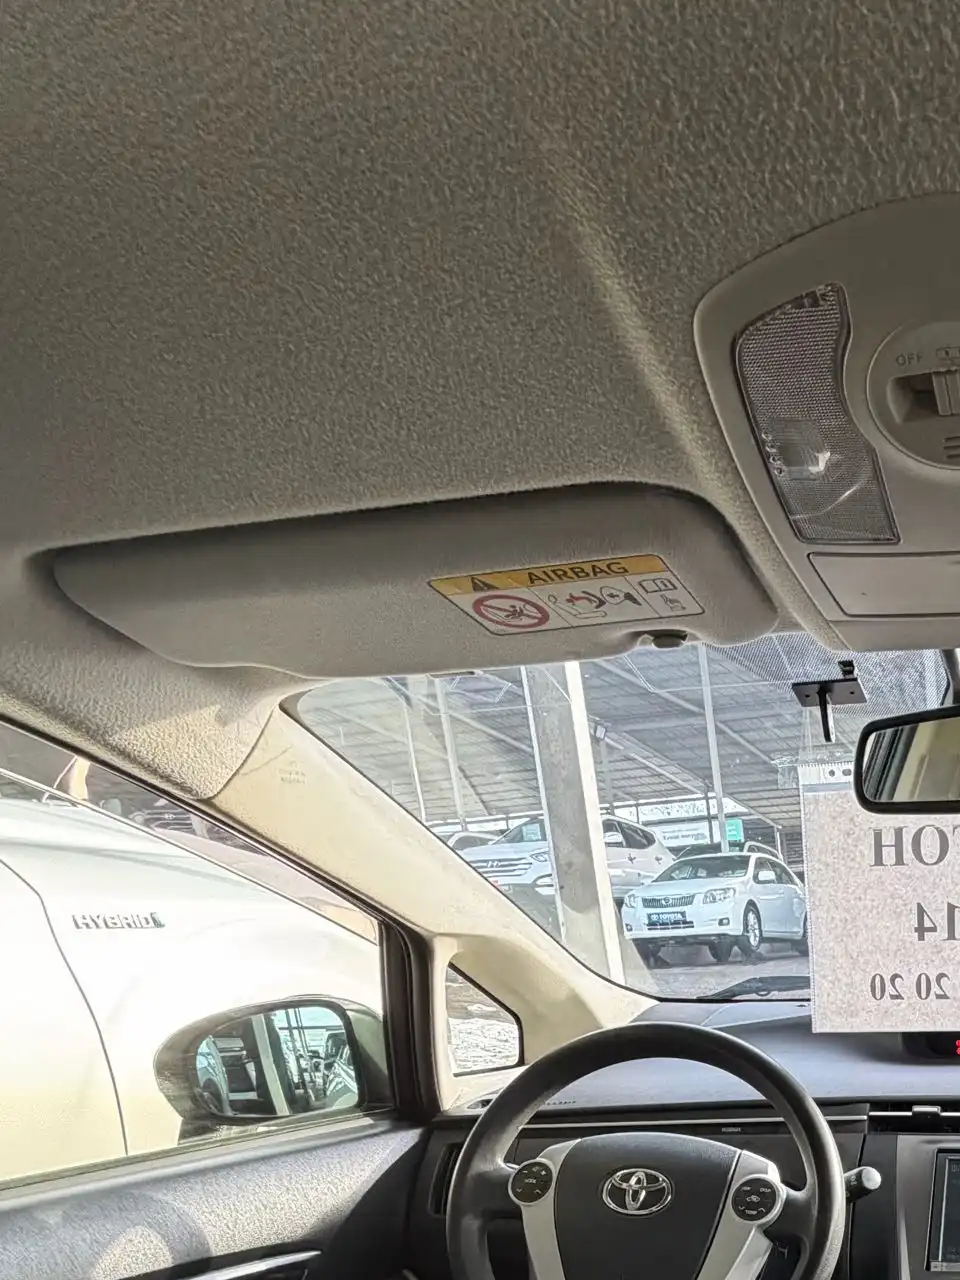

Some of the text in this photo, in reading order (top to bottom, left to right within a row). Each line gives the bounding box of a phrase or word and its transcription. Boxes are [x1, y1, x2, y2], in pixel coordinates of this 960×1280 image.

[895, 353, 923, 367] OFF
[527, 561, 630, 586] AIRBAG
[71, 912, 158, 930] HYBRID
